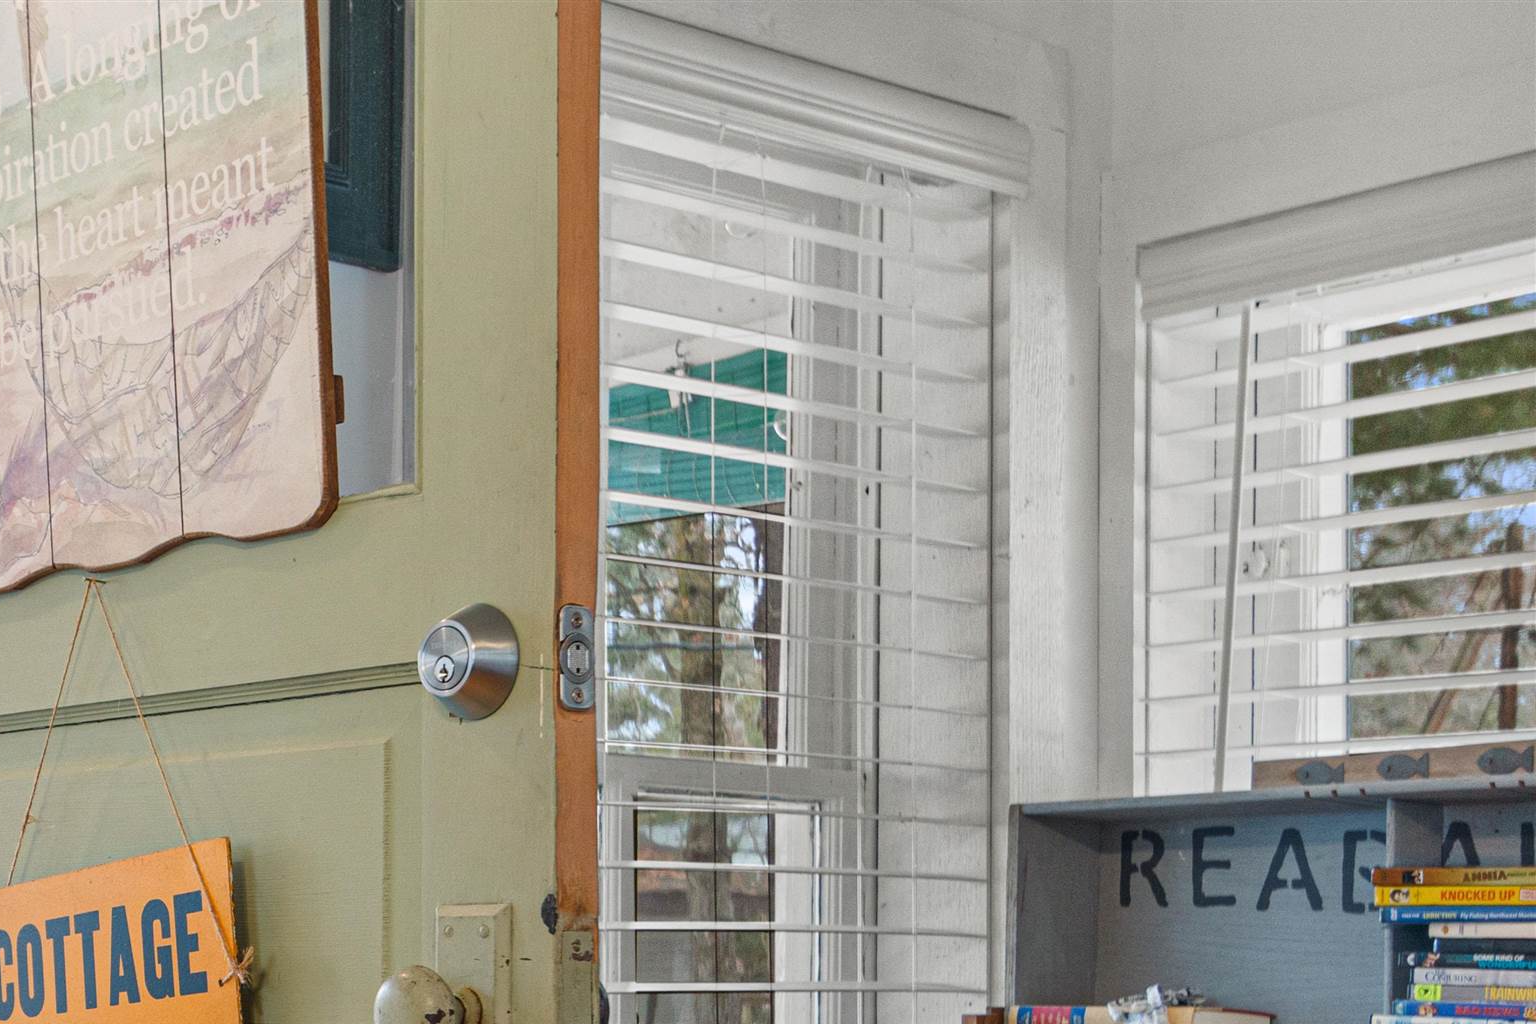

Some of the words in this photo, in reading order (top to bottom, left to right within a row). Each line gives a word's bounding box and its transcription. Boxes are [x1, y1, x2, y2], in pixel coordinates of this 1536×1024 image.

[26, 50, 56, 110] A
[63, 0, 209, 94] longing
[123, 36, 264, 152] created
[54, 184, 146, 264] heart
[151, 136, 277, 223] meant
[49, 246, 208, 374] pursued.
[1440, 889, 1496, 902] KNOCKED
[1499, 890, 1516, 902] UP
[1473, 953, 1495, 962] SOME
[1496, 953, 1514, 962] KIND
[1514, 954, 1525, 962] OF
